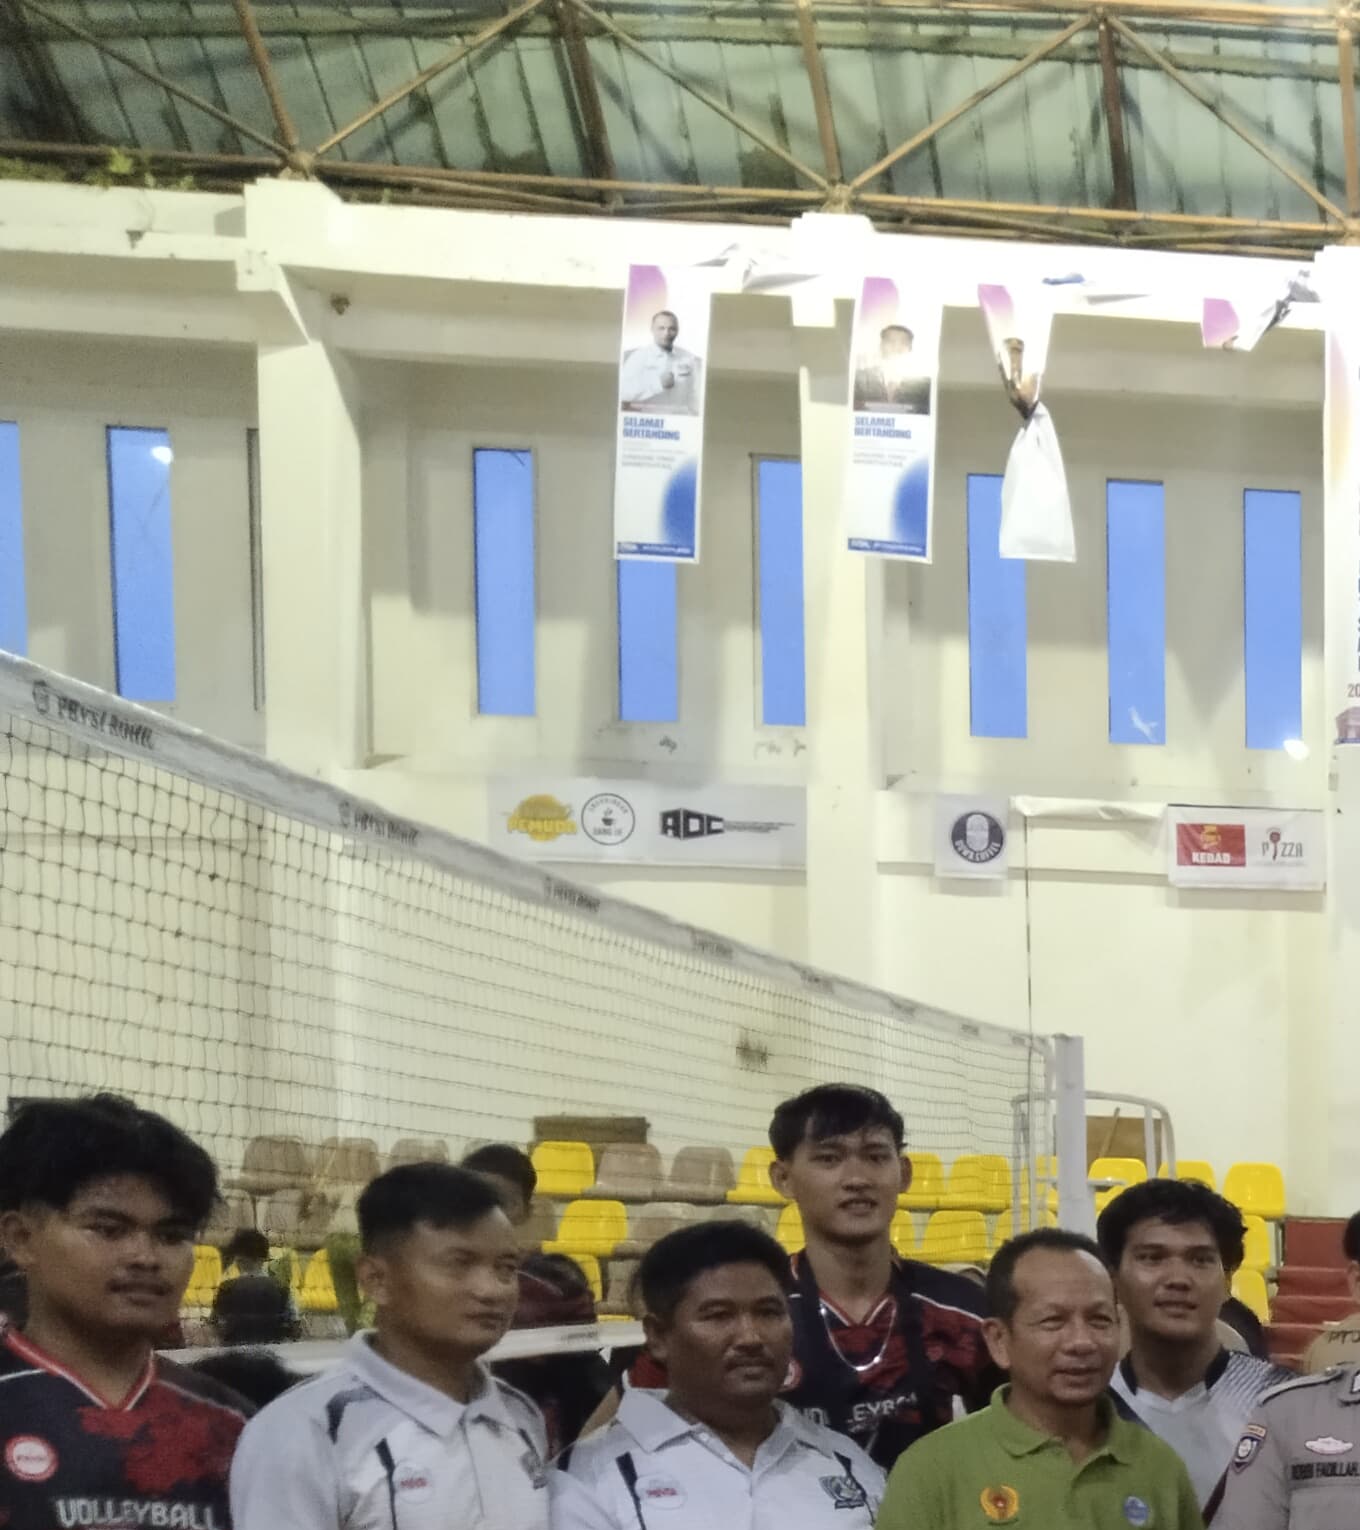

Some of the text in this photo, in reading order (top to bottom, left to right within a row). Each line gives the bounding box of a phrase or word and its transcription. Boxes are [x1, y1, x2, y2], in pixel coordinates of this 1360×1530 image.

[623, 416, 664, 428] SELAMAT
[855, 416, 895, 427] SELAMAT
[623, 427, 680, 440] BERTANDING
[854, 427, 911, 439] BERTANDING
